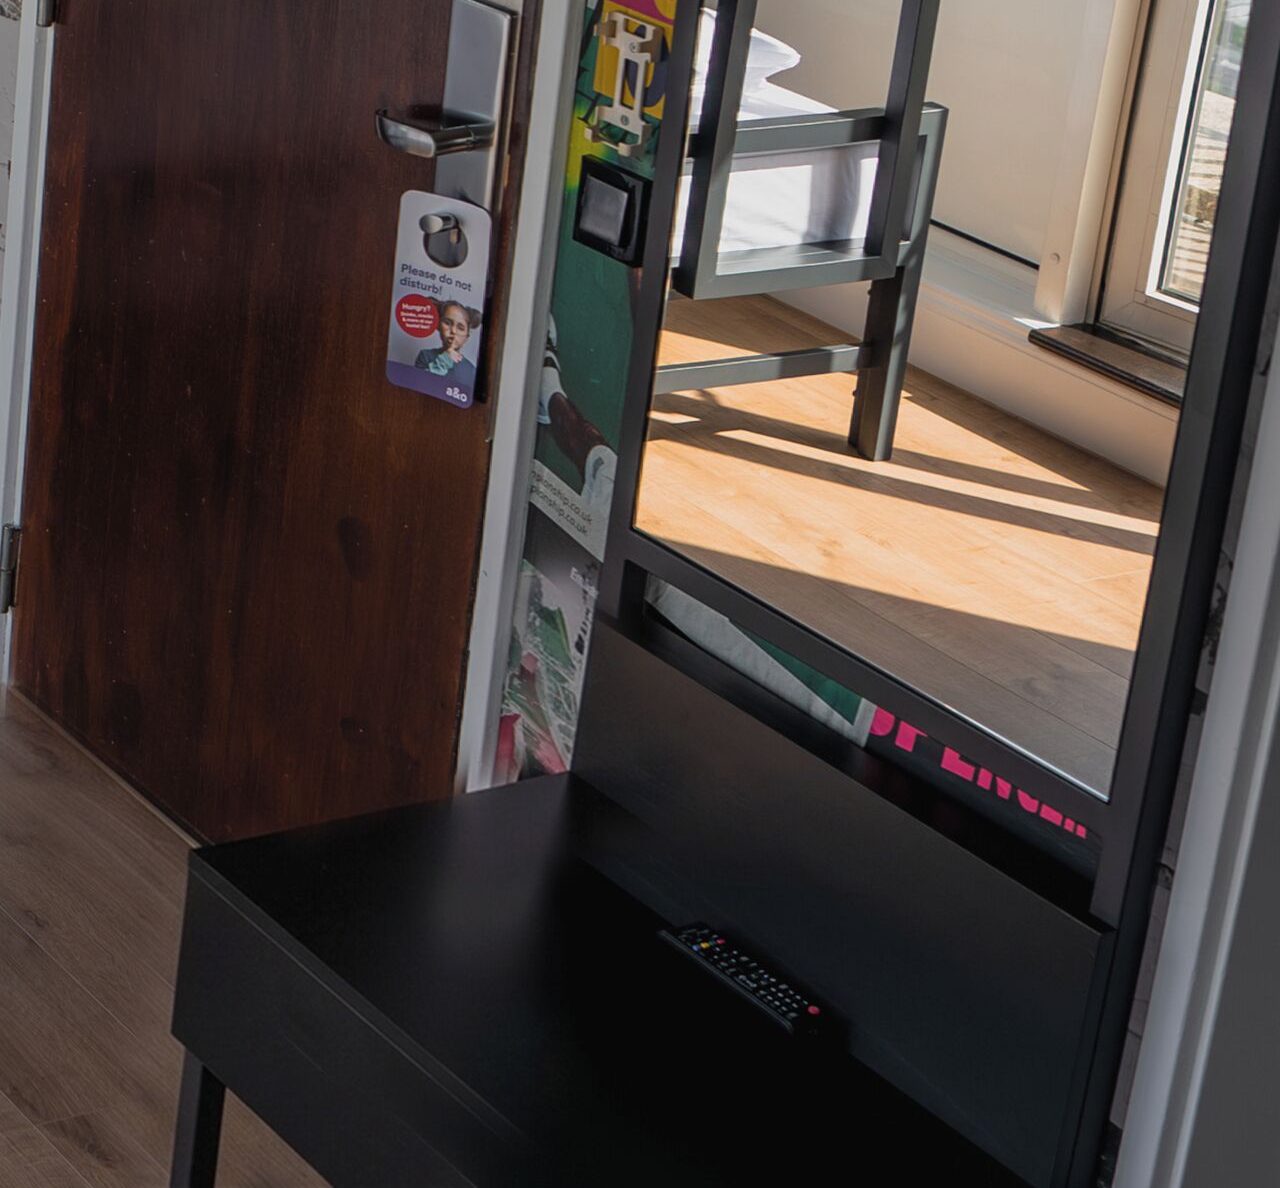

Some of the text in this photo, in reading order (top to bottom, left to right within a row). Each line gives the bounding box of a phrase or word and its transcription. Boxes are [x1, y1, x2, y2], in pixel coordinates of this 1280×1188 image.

[399, 276, 443, 296] disturb!
[401, 263, 472, 292] Please do not
[446, 385, 468, 403] a&o
